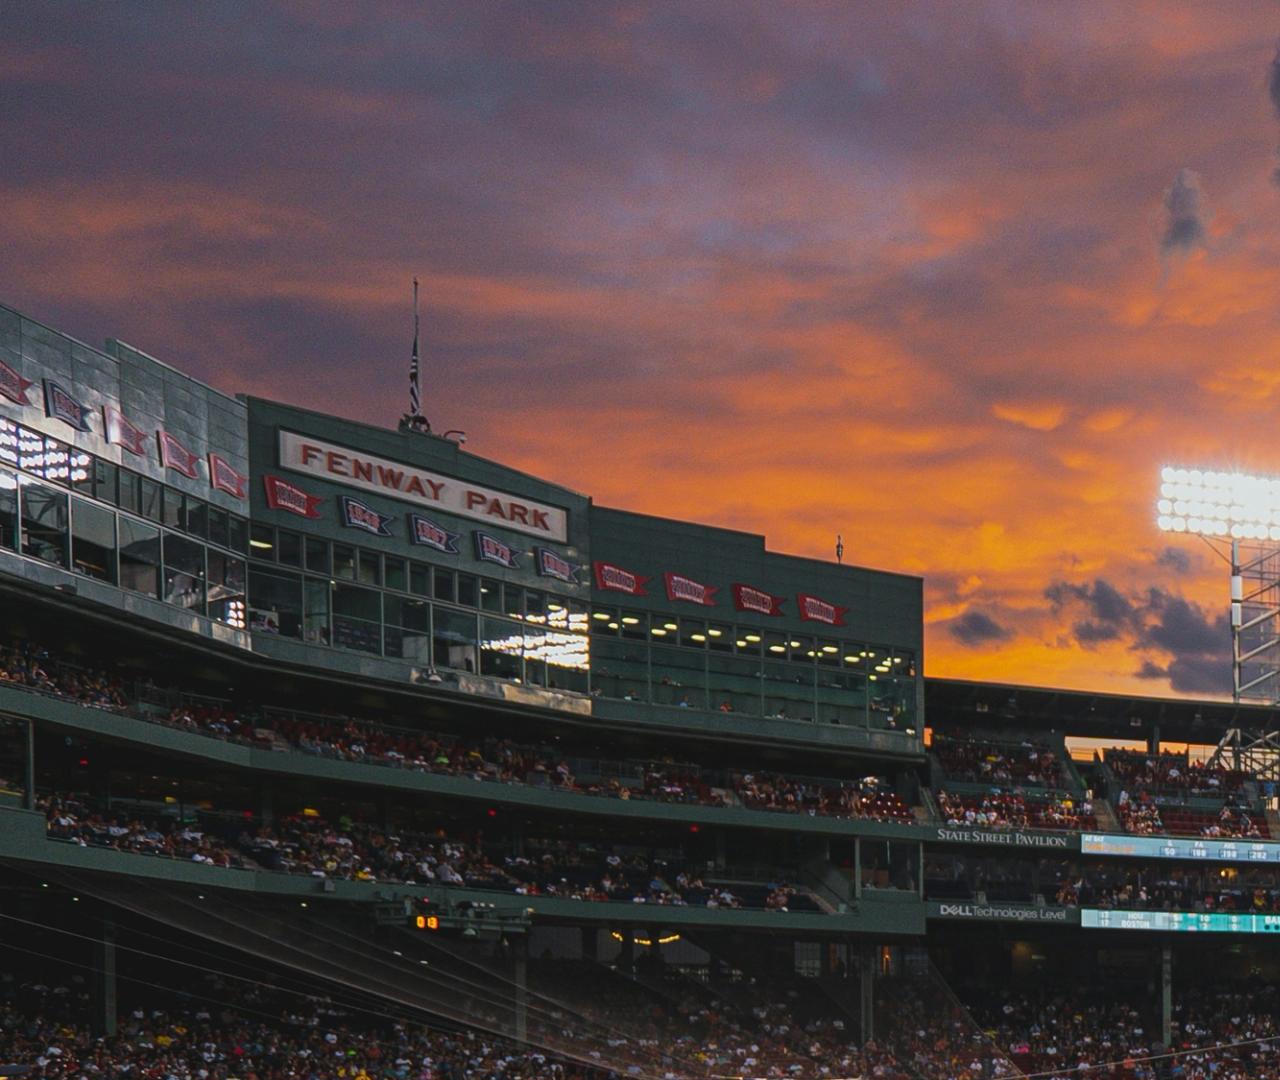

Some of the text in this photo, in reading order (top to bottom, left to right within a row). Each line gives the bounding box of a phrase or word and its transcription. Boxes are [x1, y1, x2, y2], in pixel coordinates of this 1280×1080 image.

[301, 444, 446, 501] FENWAY
[465, 489, 551, 532] PARK
[938, 829, 1067, 847] STATE STREET PAVILION
[1040, 908, 1066, 920] Level
[1121, 919, 1149, 928] BOSTON
